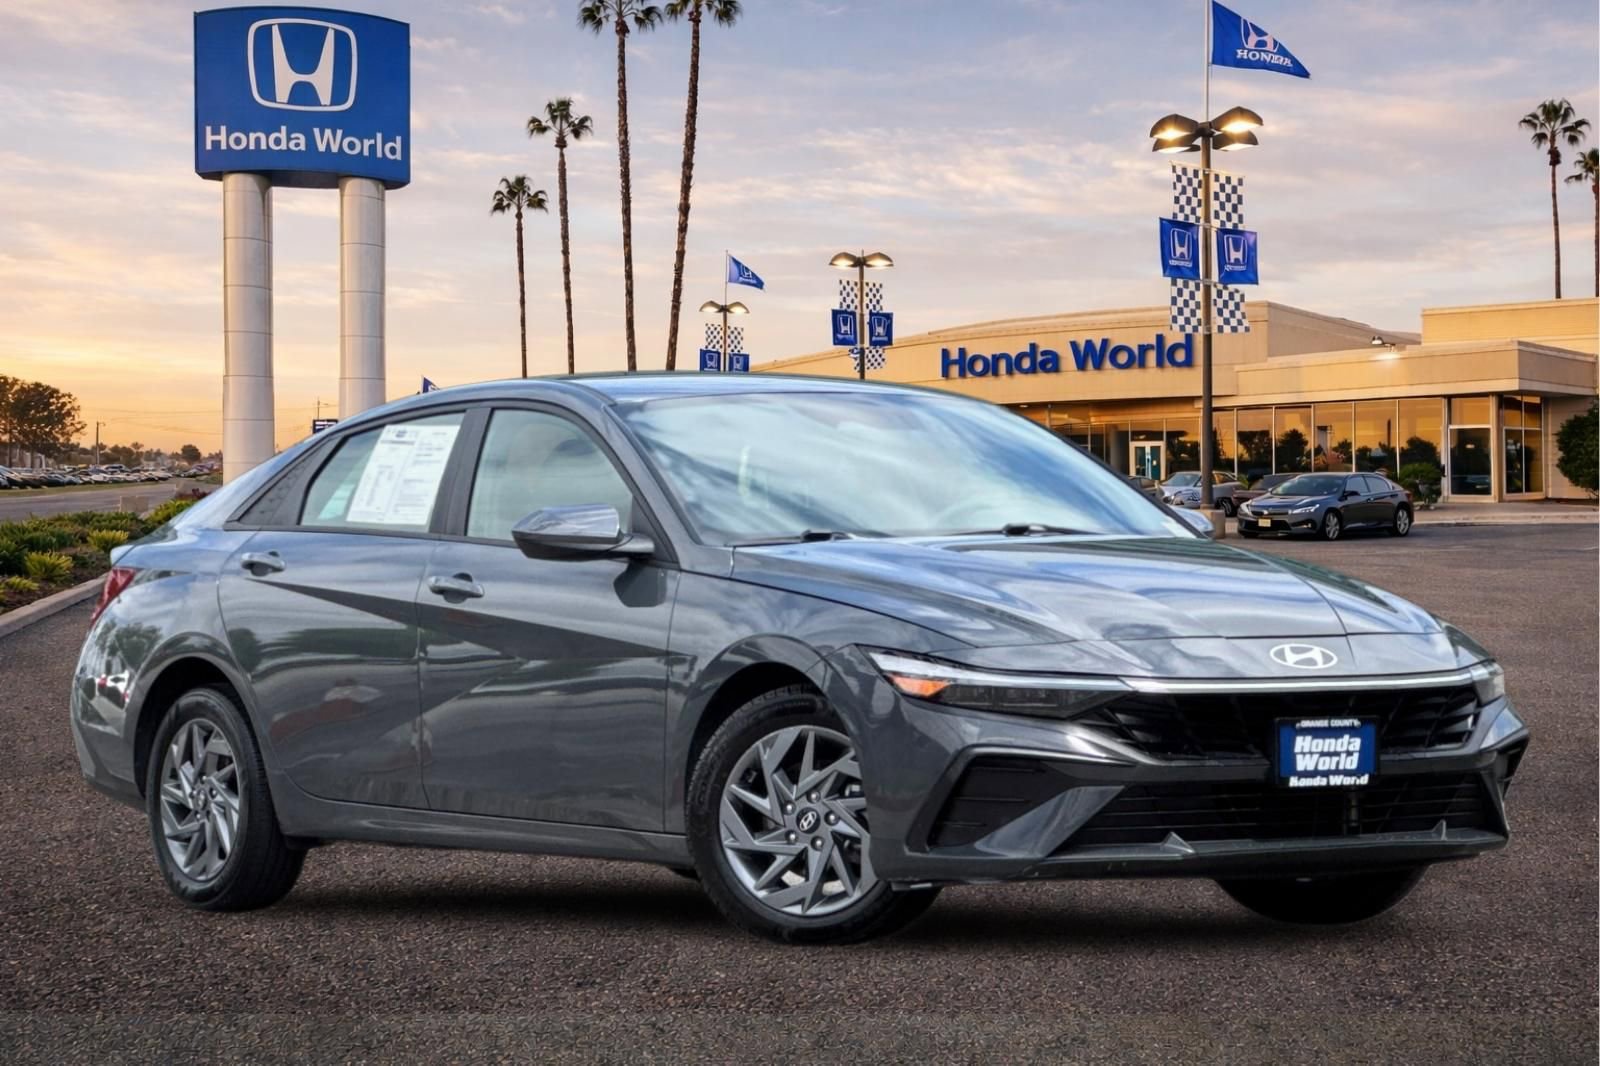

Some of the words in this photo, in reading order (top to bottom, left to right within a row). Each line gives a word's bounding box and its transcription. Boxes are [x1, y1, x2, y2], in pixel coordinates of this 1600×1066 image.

[205, 125, 306, 151] Honda
[313, 127, 402, 160] World
[940, 342, 1060, 378] Honda
[1069, 333, 1194, 371] World
[1294, 734, 1361, 753] Honda
[1296, 751, 1359, 771] World
[1289, 775, 1327, 787] Honda
